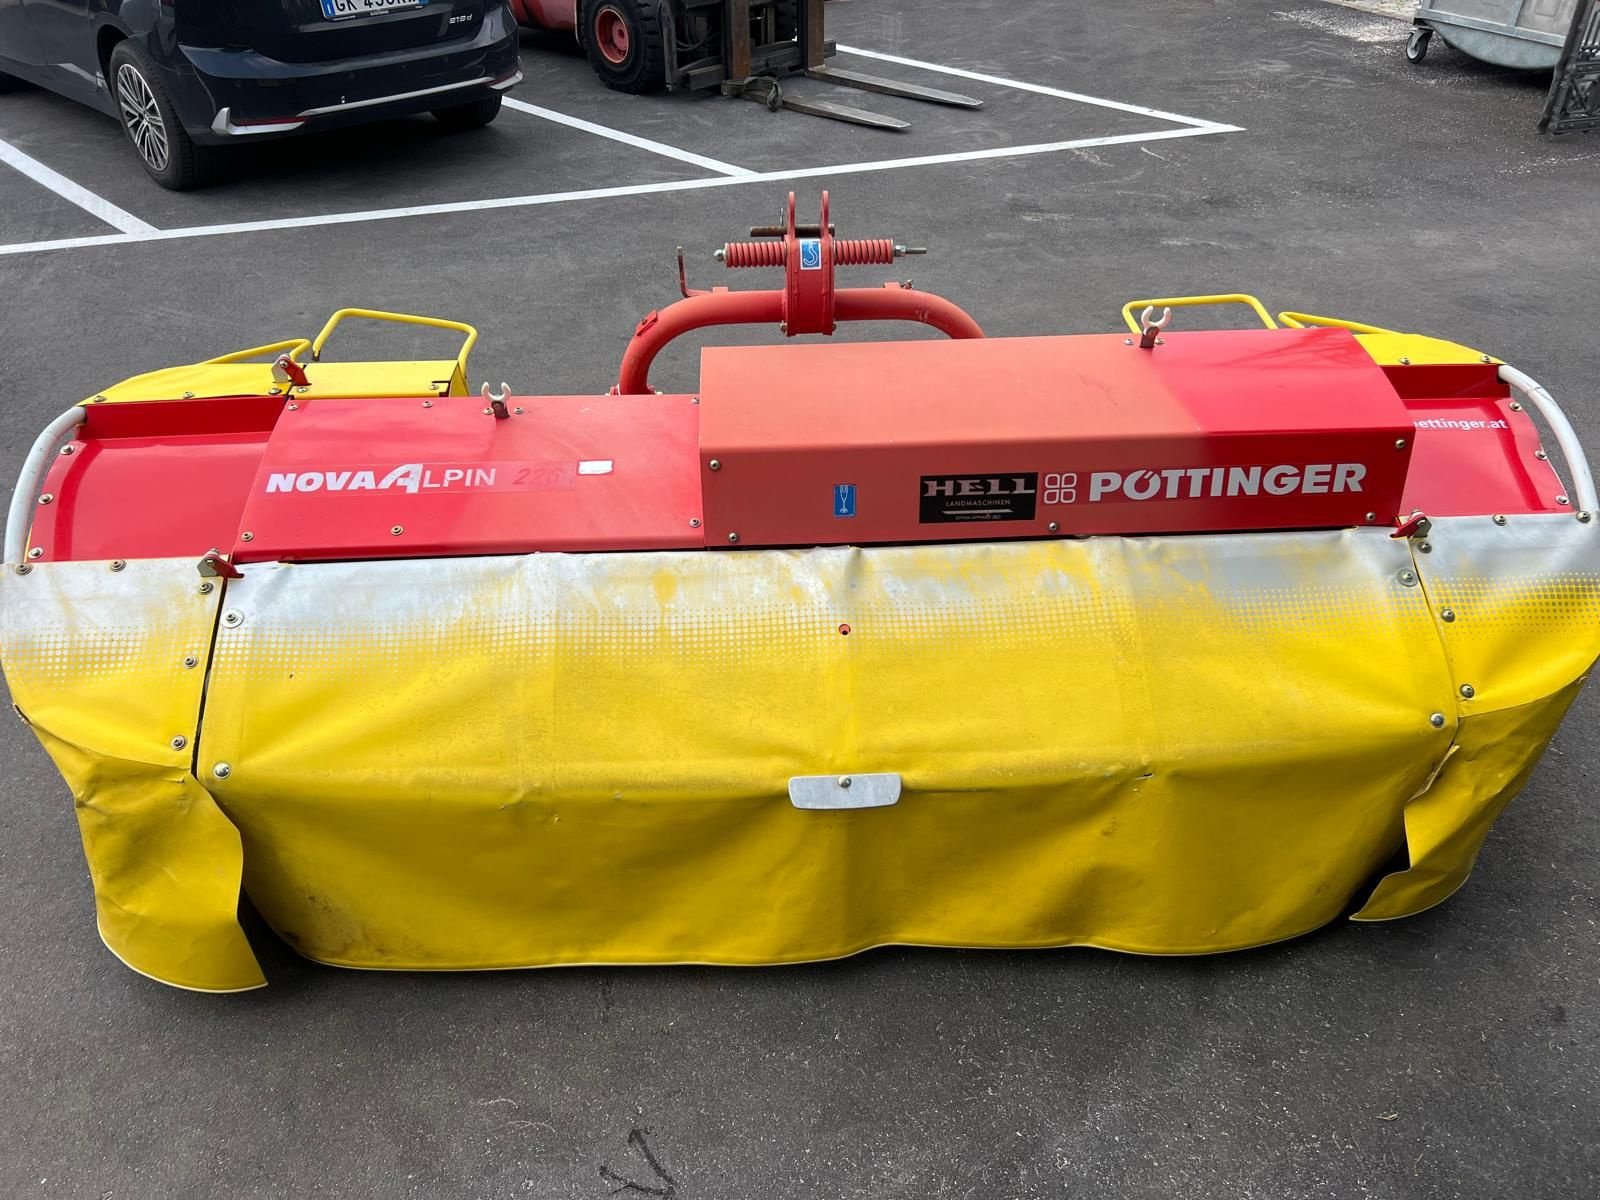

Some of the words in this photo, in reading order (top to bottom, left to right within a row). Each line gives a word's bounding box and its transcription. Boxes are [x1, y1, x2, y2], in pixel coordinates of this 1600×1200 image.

[923, 478, 1036, 497] HELL
[1089, 463, 1367, 502] PÖTTINGER
[945, 499, 1011, 508] LANDMASCHINEN
